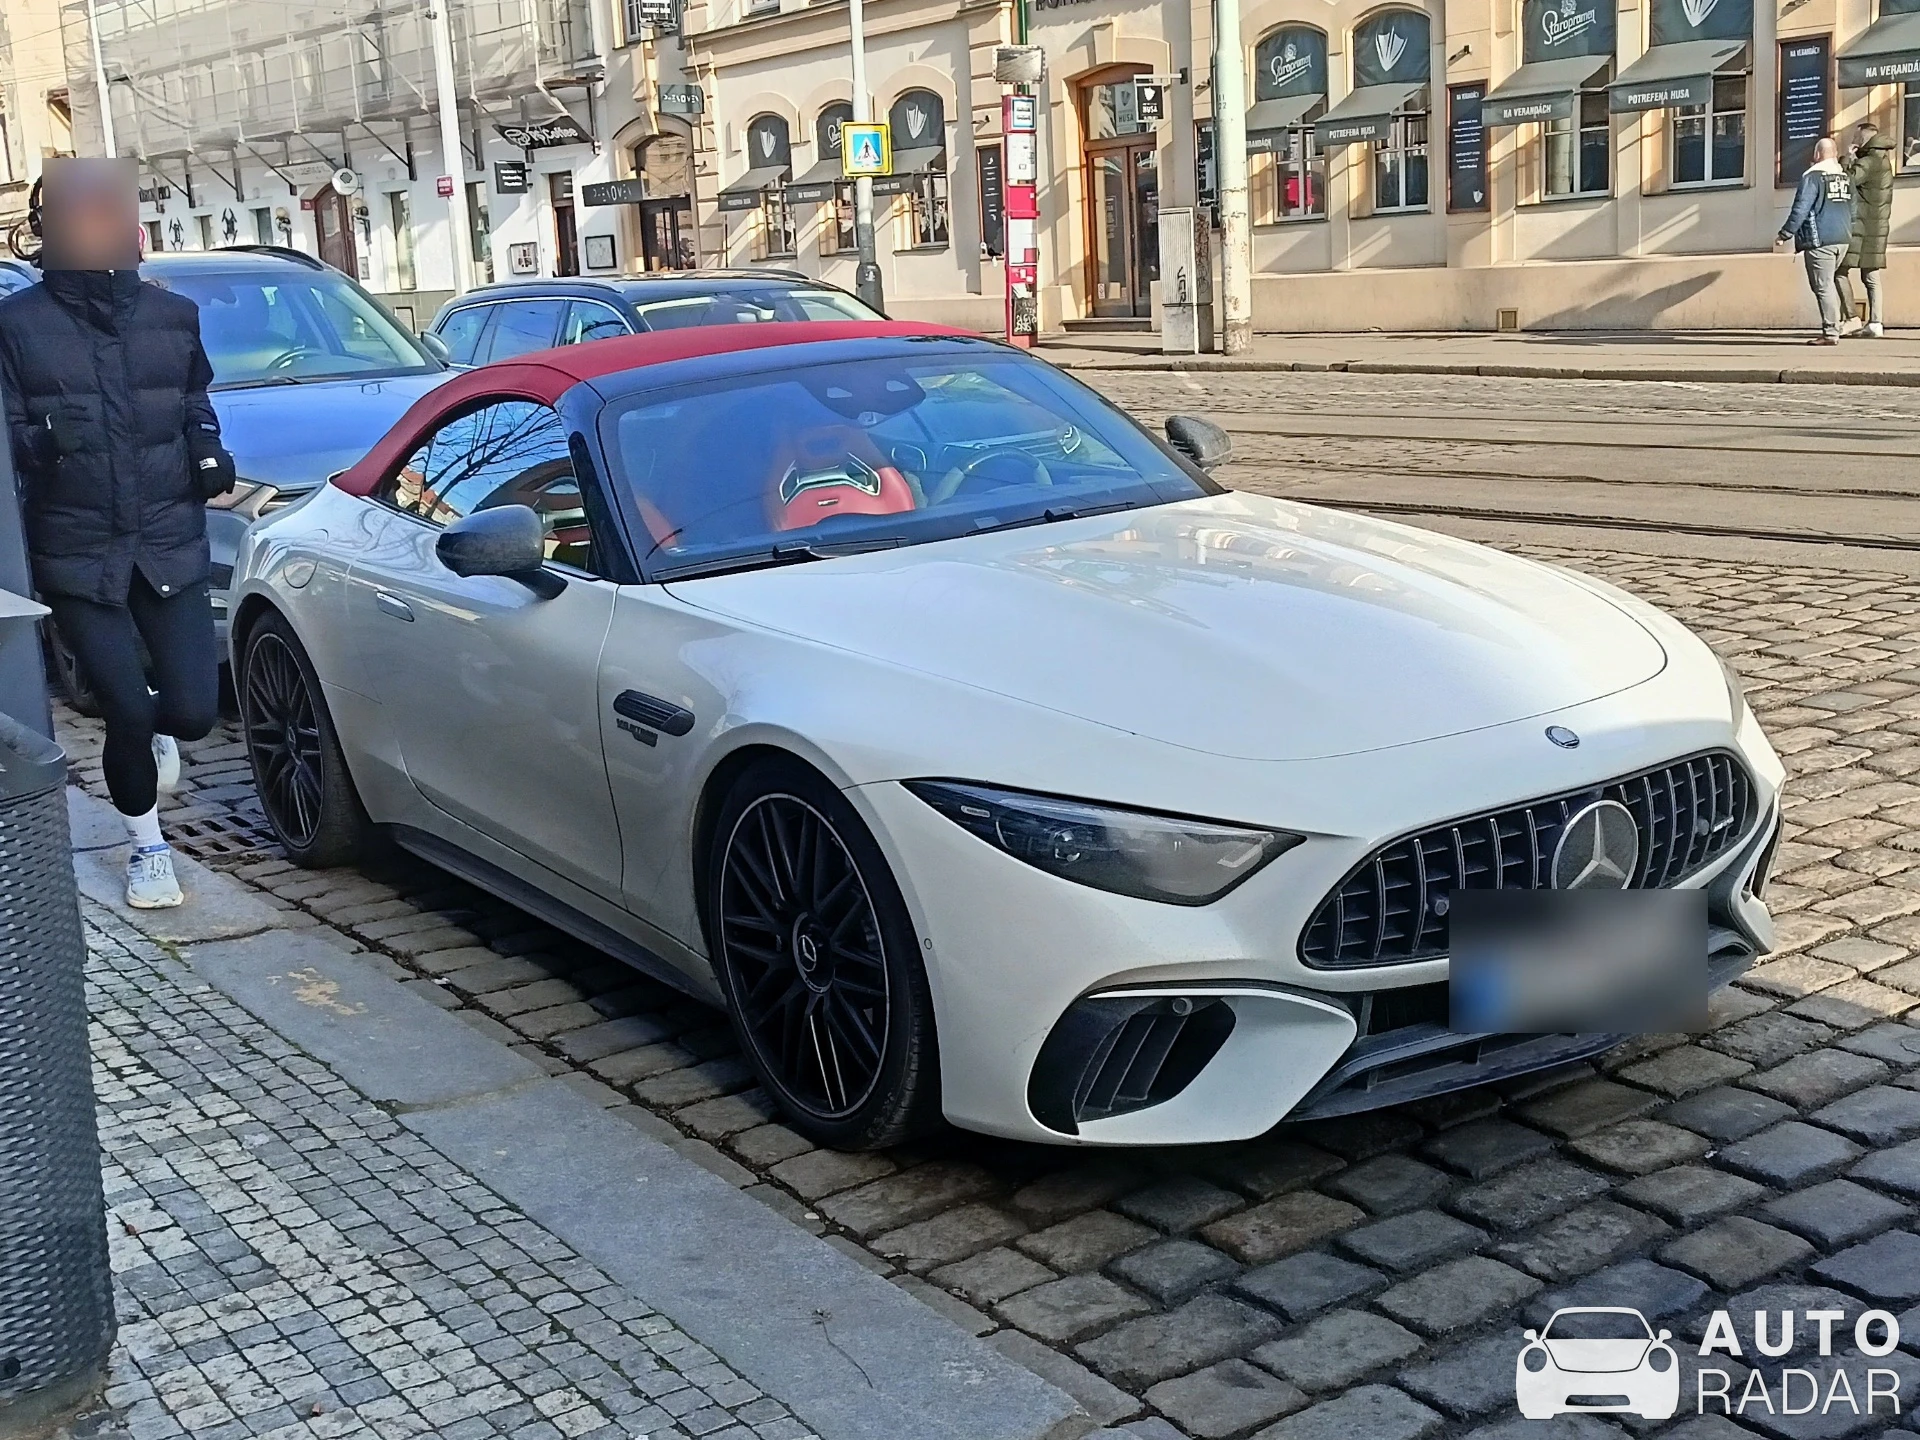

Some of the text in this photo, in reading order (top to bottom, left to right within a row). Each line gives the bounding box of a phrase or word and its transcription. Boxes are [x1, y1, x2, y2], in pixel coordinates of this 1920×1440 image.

[1542, 7, 1597, 45] Staropramen
[1271, 53, 1313, 86] Staropramen
[1866, 59, 1920, 78] NA VERANDÁ
[1628, 89, 1690, 104] POTREFENÁ HUSA
[1142, 105, 1158, 114] HUSA
[1503, 103, 1552, 118] NA VERANDÁCH
[1118, 113, 1134, 122] HUSA
[1360, 125, 1376, 136] HUSA
[1245, 137, 1272, 149] ERANDÁCH
